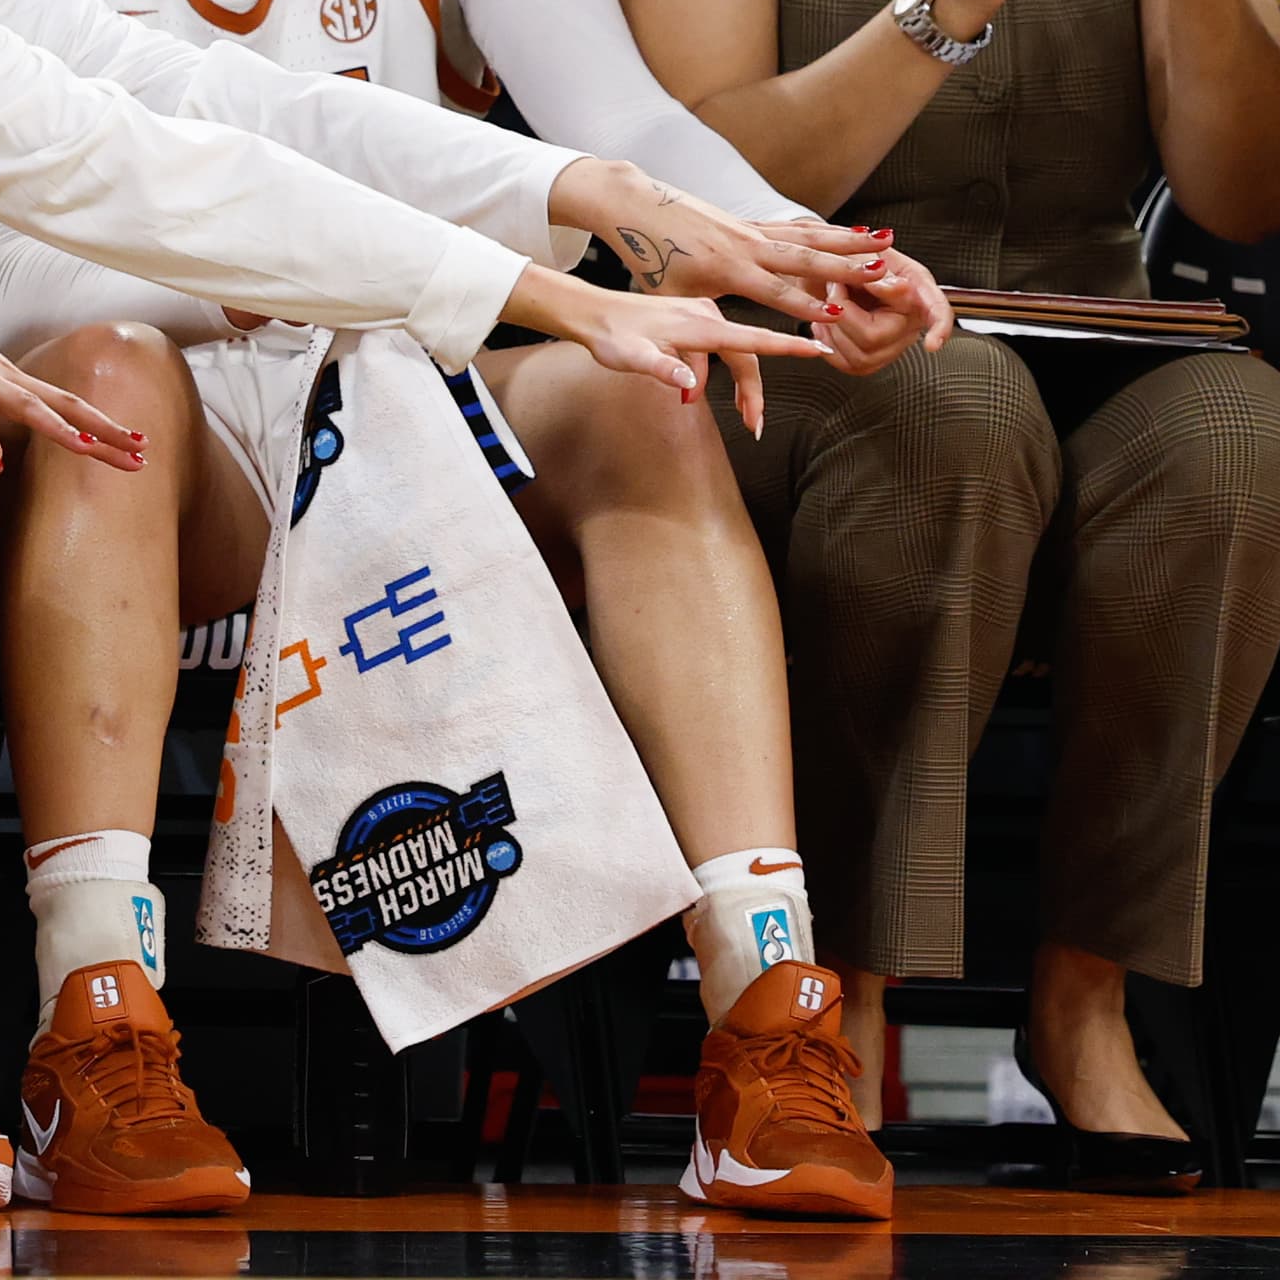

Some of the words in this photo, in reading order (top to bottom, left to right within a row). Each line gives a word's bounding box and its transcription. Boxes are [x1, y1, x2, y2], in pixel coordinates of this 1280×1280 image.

[379, 792, 413, 814] ELITE
[313, 820, 458, 914] MADNESS
[377, 847, 486, 927] MARCH
